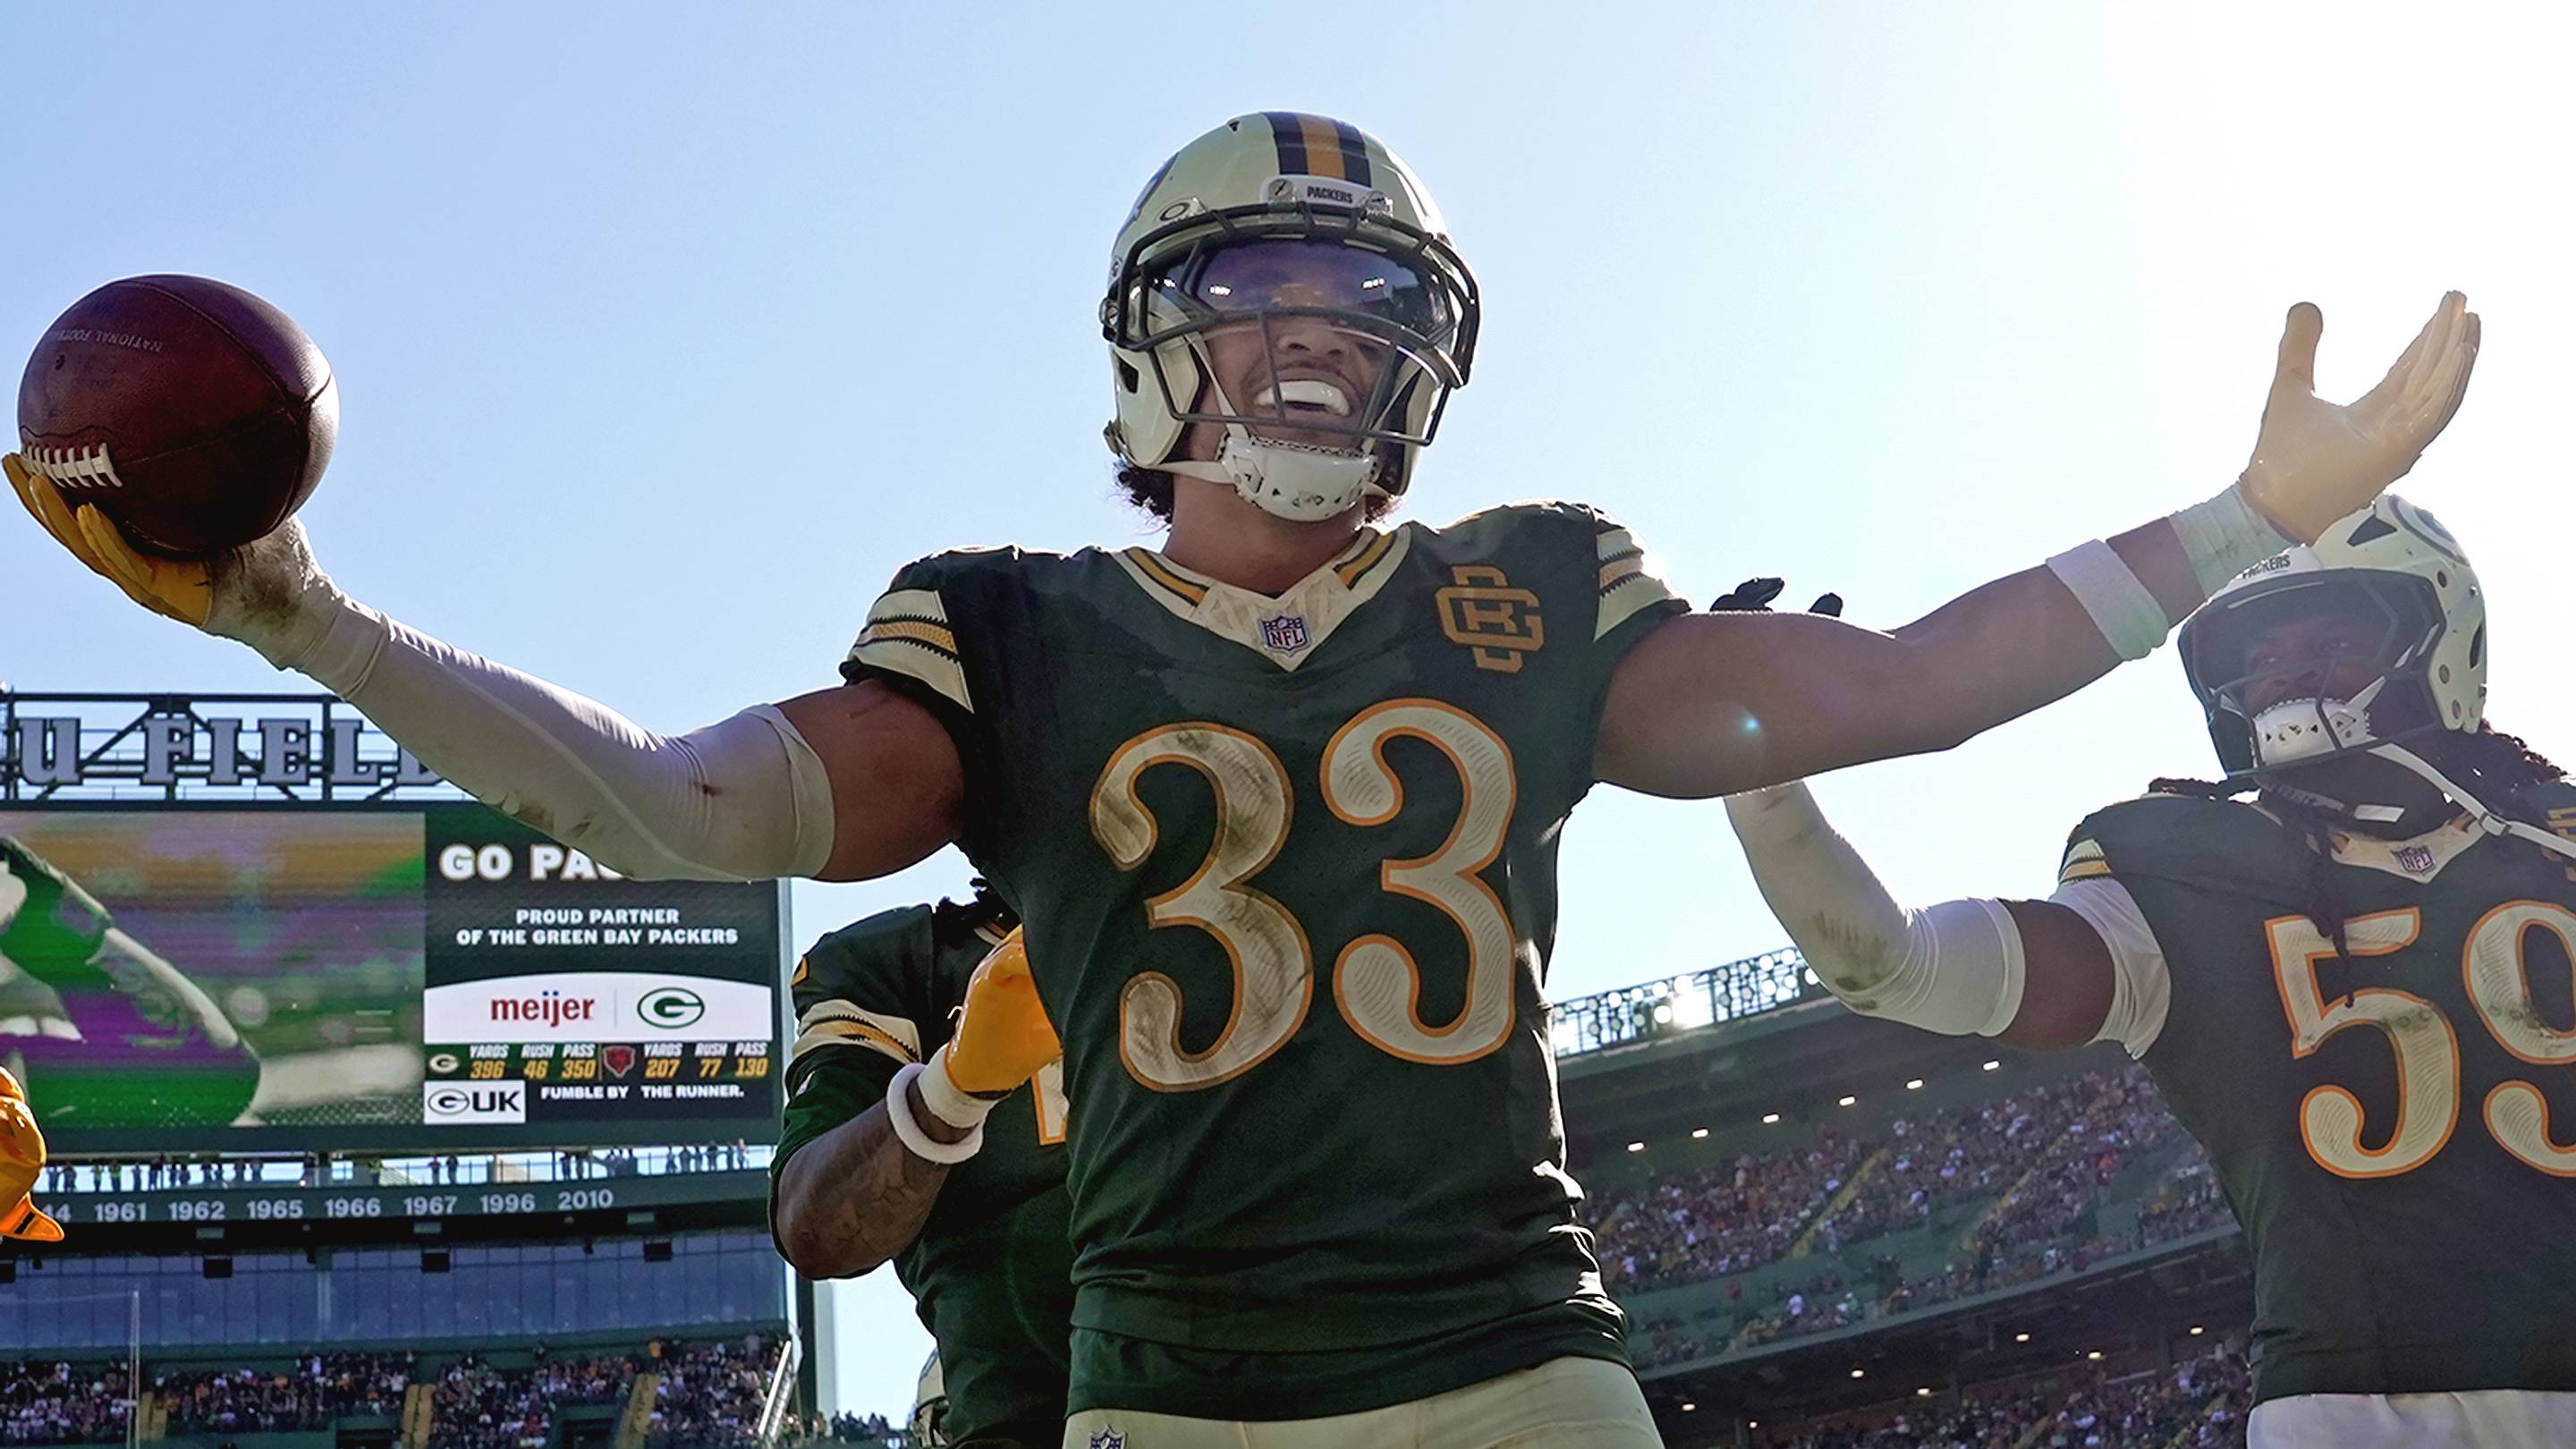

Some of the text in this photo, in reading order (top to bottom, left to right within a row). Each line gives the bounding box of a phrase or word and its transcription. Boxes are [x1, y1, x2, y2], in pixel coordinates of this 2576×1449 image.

[1307, 186, 1353, 204] PACKERS
[95, 329, 163, 352] NATIONAL
[1268, 629, 1306, 647] NFL
[440, 843, 513, 881] GO
[1089, 698, 1517, 1092] 33
[516, 909, 680, 924] PROUD PARTNER
[456, 928, 739, 945] OF THE GREEN BAY PACKERS
[491, 990, 595, 1028] meijer
[2264, 900, 2576, 1178] 59
[470, 1043, 596, 1058] YARDS RUSH PASS
[644, 1042, 767, 1057] YARDS RUSH PASS
[470, 1059, 597, 1079] 396 46 350
[645, 1057, 768, 1078] 207 77 130
[541, 1084, 745, 1099] FUMBLE BY THE RUNNER.
[94, 1203, 148, 1222] 1961
[168, 1202, 225, 1221] 1962
[247, 1199, 304, 1219] 1965
[325, 1197, 382, 1218] 1966
[403, 1195, 458, 1216] 1967
[479, 1193, 537, 1214] 1996
[557, 1189, 614, 1211] 2010
